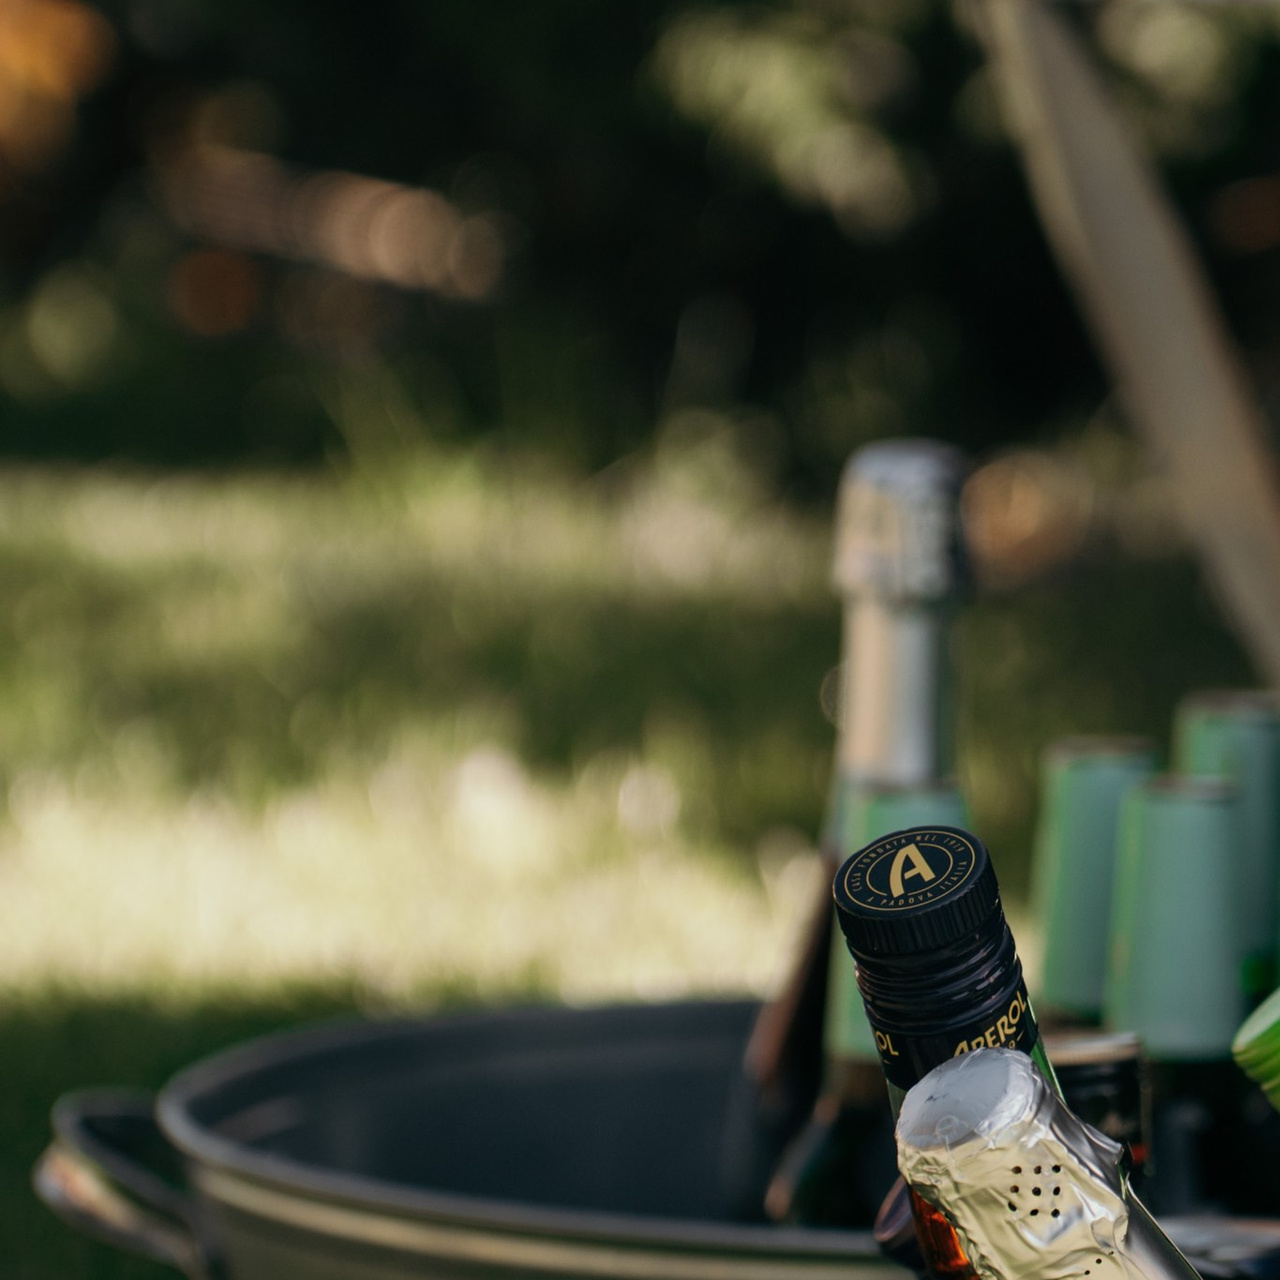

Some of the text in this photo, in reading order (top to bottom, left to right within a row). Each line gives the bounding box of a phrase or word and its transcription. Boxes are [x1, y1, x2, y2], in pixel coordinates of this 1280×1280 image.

[858, 838, 907, 868] FONDATA
[889, 842, 936, 898] A
[880, 891, 934, 906] PADOVA
[939, 860, 967, 890] ITALIA
